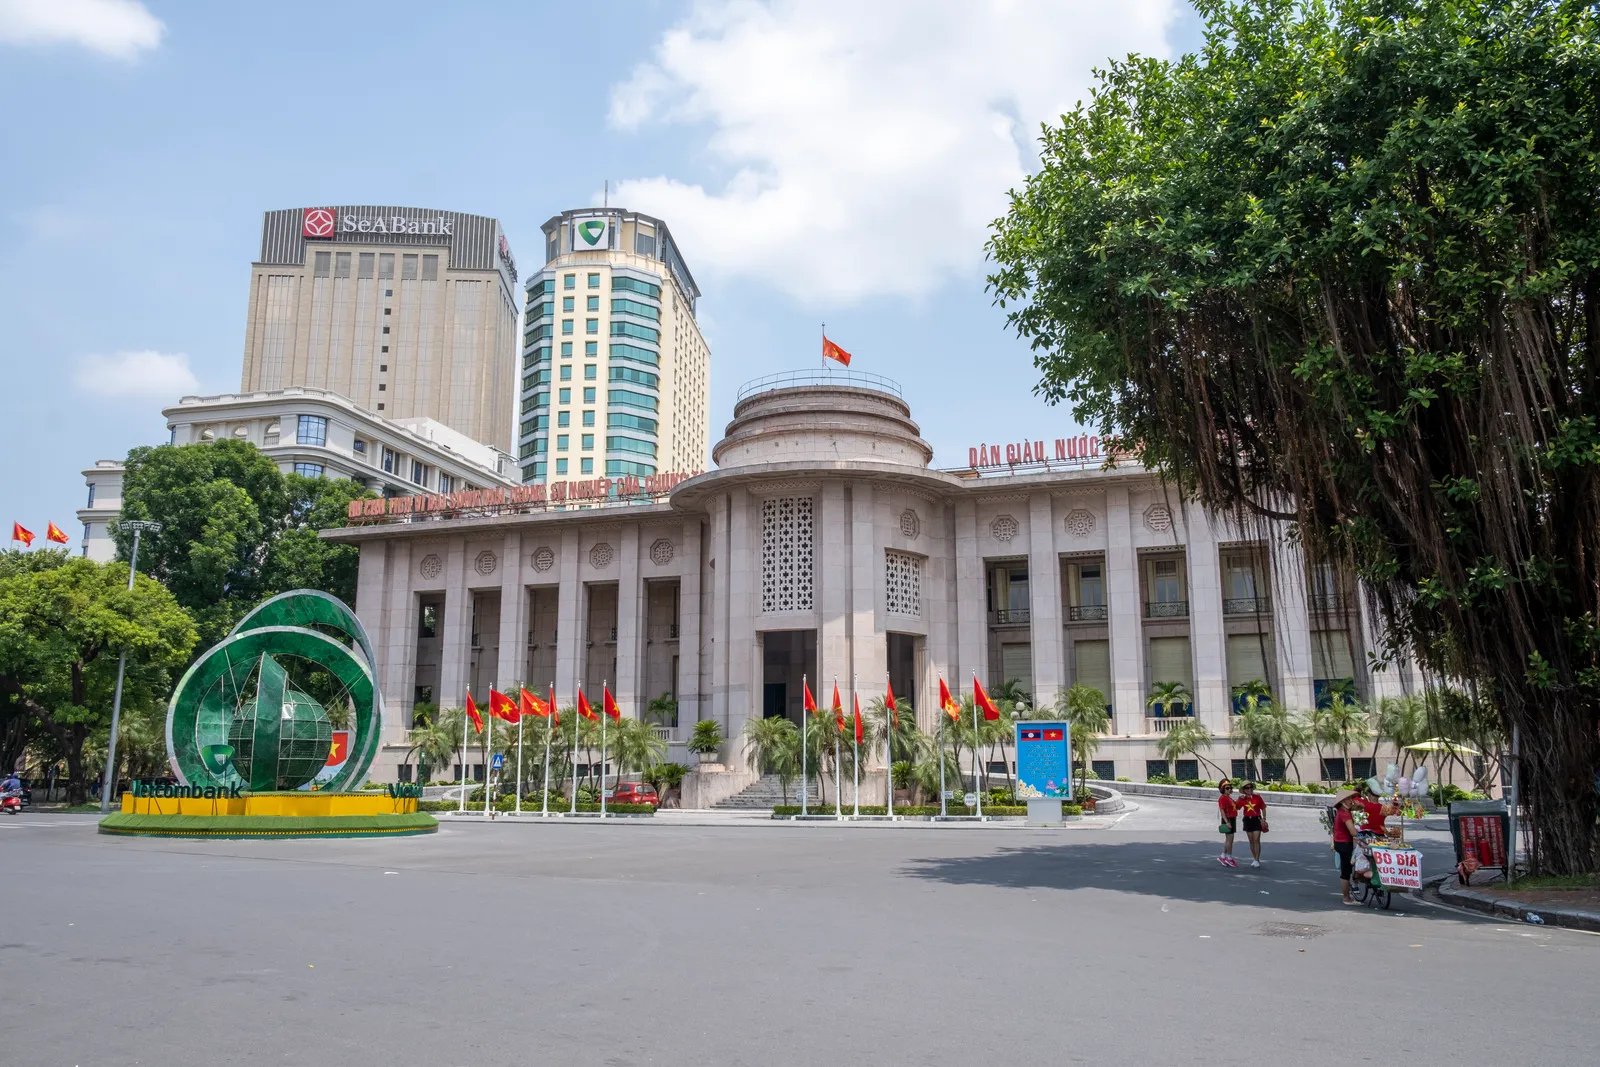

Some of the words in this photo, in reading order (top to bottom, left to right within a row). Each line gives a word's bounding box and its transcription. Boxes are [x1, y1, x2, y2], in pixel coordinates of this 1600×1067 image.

[342, 214, 453, 236] SeABank
[968, 442, 1002, 468] DÂN
[1055, 431, 1099, 460] NƯỚC
[568, 476, 613, 500] NGHIỆP
[616, 471, 641, 496] CỦA
[1373, 850, 1392, 865] BÒ
[1396, 851, 1418, 867] BÍA
[1398, 866, 1418, 877] XÍCH
